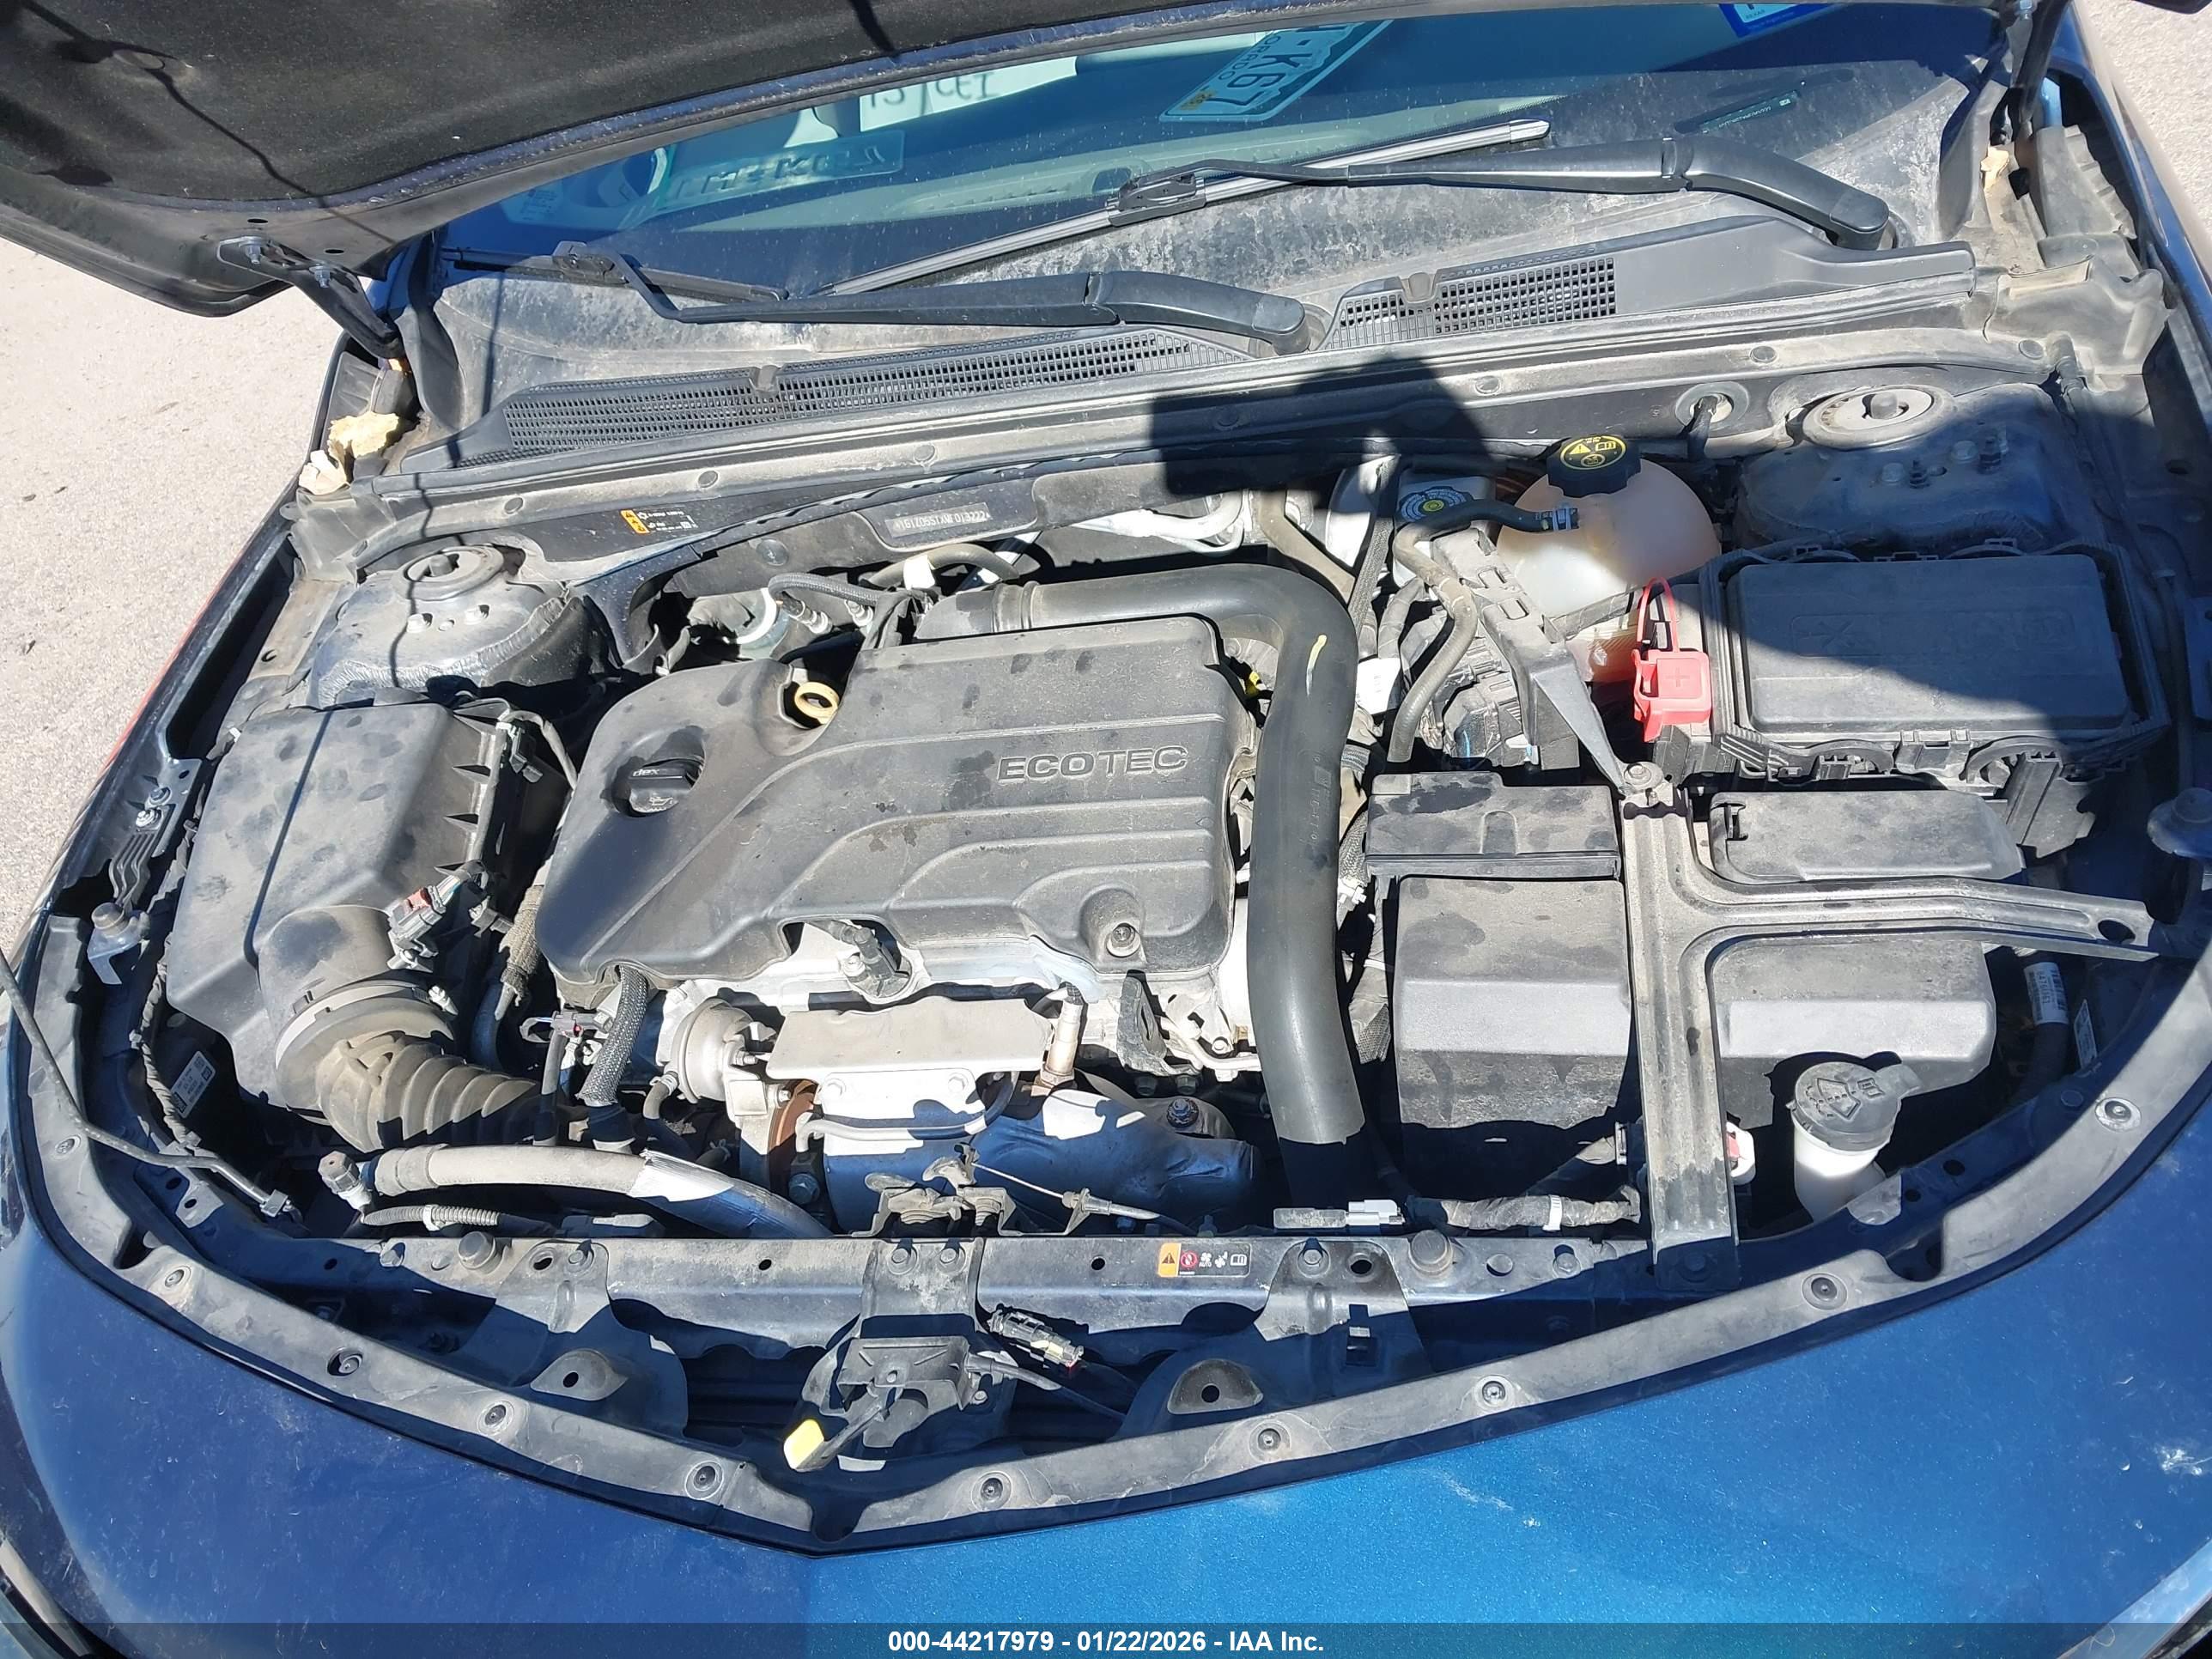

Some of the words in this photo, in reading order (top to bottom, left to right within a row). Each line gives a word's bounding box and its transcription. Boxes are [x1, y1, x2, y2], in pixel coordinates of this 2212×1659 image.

[1208, 25, 1347, 106] -K67
[1218, 35, 1281, 82] ORADO
[997, 744, 1189, 784] ECOTEC
